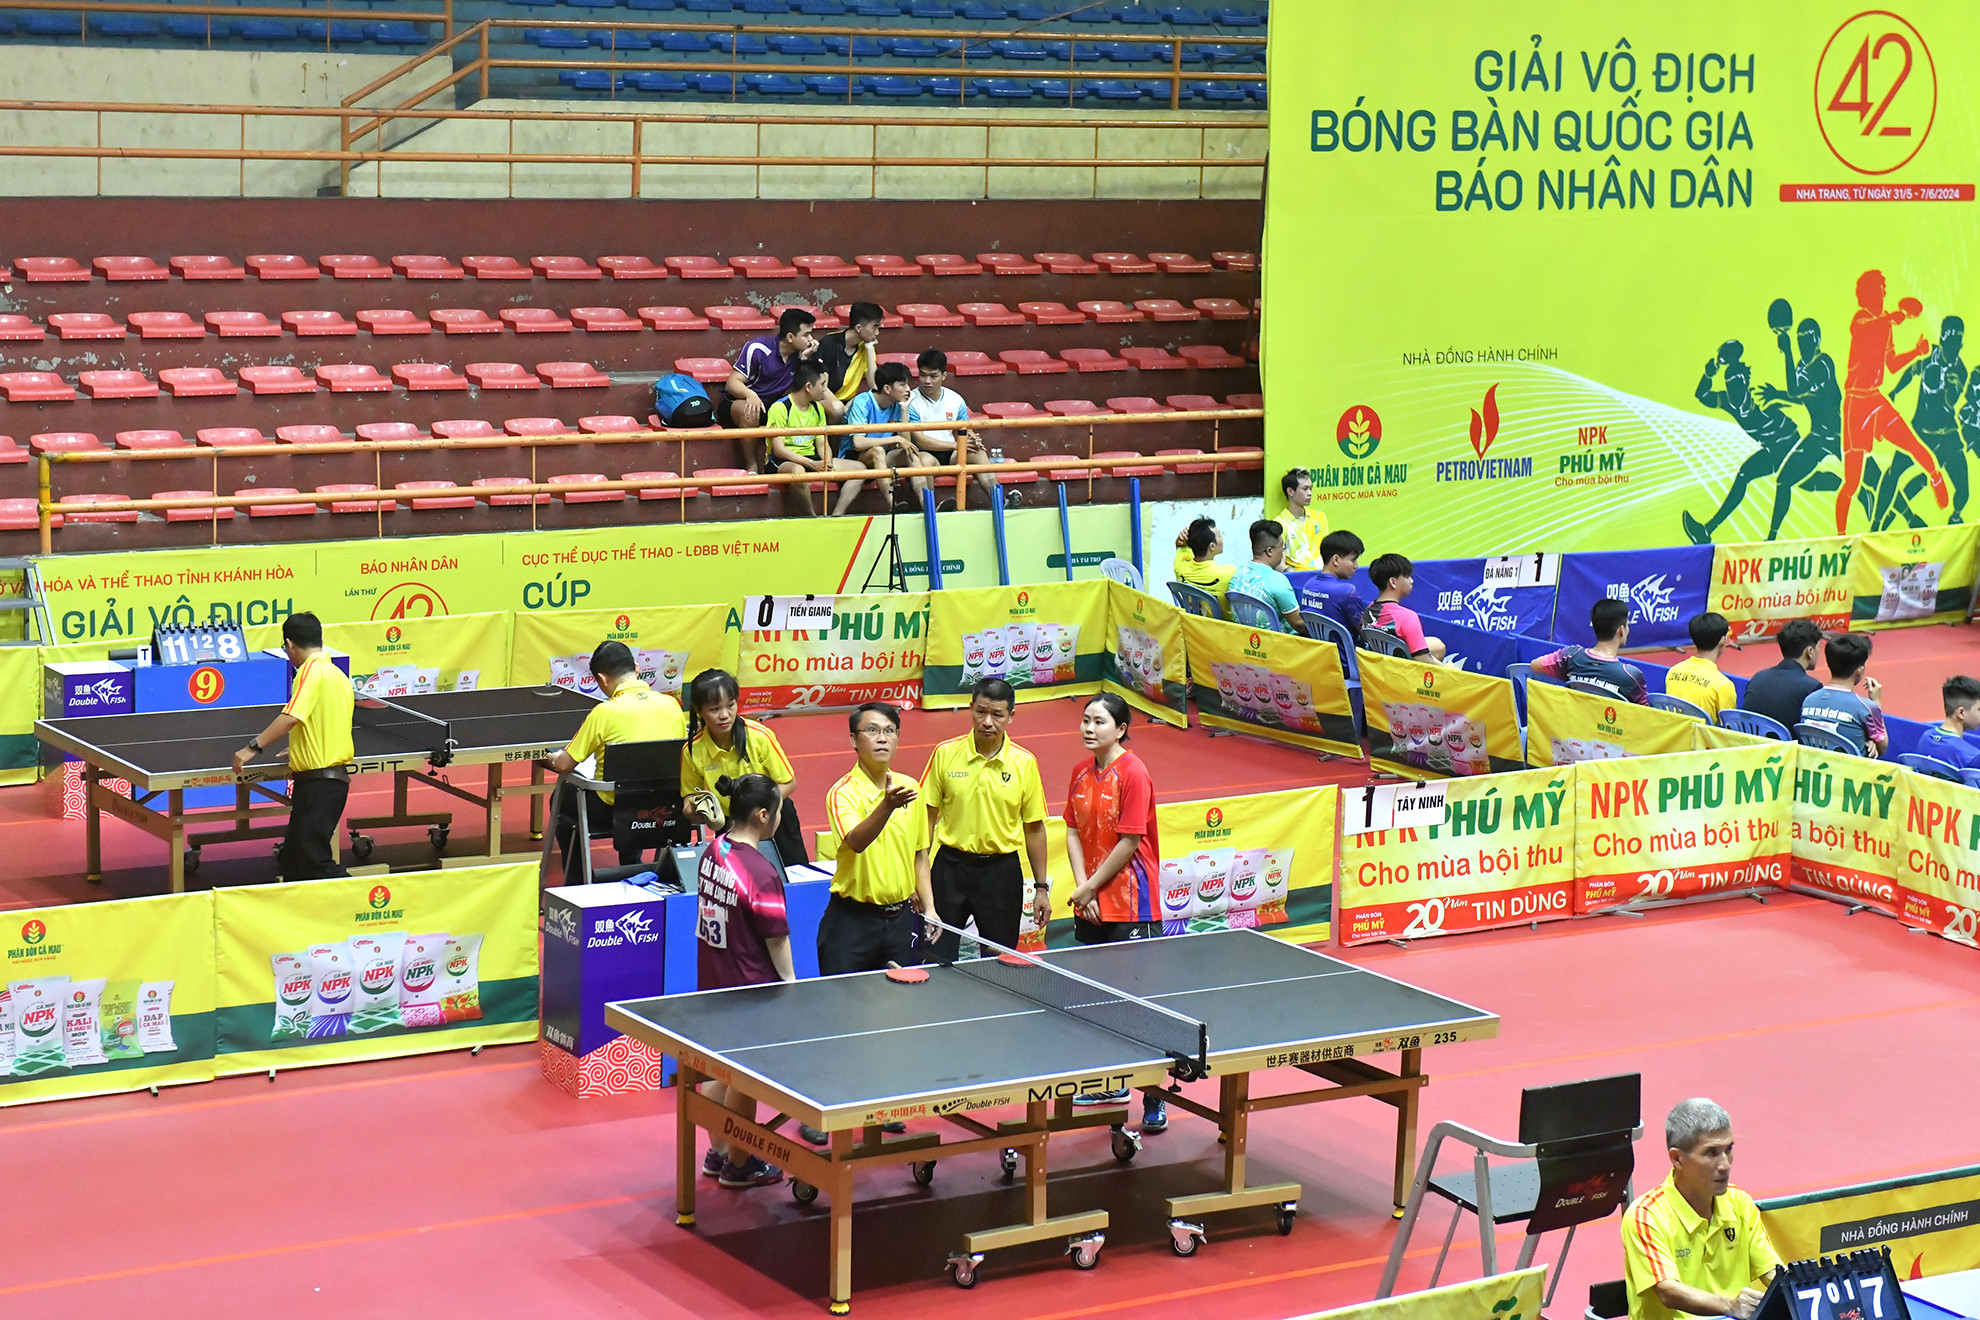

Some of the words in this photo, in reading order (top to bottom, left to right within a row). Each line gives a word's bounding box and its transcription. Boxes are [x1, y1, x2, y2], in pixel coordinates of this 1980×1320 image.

[1475, 34, 1562, 92] GIẢI
[1580, 37, 1636, 92] VÔ
[1652, 52, 1755, 103] ĐỊCH
[1827, 33, 1912, 136] 42
[1310, 96, 1436, 152] BÓNG
[1451, 97, 1539, 151] BÀN
[1554, 90, 1672, 152] QUỐC
[1686, 111, 1753, 151] GIA
[1436, 157, 1523, 211] BÁO
[1538, 154, 1655, 210] NHÂN
[1670, 154, 1752, 208] DÂN
[1796, 188, 1817, 199] NHA
[1818, 188, 1851, 201] TRANG,
[1853, 187, 1867, 199] TỪ
[1868, 186, 1892, 199] NGÀY
[1893, 188, 1912, 199] 31/5
[1920, 187, 1960, 200] 7/6/2024
[1403, 349, 1431, 365] NHÀ
[1436, 346, 1473, 364] ĐỒNG
[1478, 348, 1514, 362] HÀNH
[1518, 345, 1558, 361] CHÍNH
[1578, 426, 1608, 445] NPK
[1437, 457, 1532, 482] PETROVIETNAM
[1559, 449, 1593, 474] PHÚ
[1600, 447, 1625, 471] MỸ
[1310, 465, 1339, 488] PHÂN
[1343, 464, 1365, 485] BÓN
[1367, 461, 1381, 484] CÀ
[1385, 463, 1407, 483] MAU
[1555, 476, 1574, 487] Cho
[1576, 474, 1596, 485] mùa
[1598, 473, 1613, 486] bội
[1615, 474, 1629, 484] thu
[1317, 493, 1331, 502] HẠT
[1332, 491, 1356, 502] NGỌC
[1359, 488, 1374, 499] MÙA
[1376, 487, 1398, 498] VÀNG
[360, 558, 388, 575] BÁO
[391, 557, 428, 572] NHÂN
[432, 555, 459, 570] DÂN
[522, 554, 549, 567] CỤC
[553, 546, 578, 564] THỂ
[582, 550, 608, 563] DỤC
[611, 542, 636, 560] THỂ
[640, 547, 674, 559] THAO
[686, 545, 719, 557] LĐBB
[723, 540, 749, 554] VIỆT
[753, 541, 780, 553] NAM
[1534, 552, 1544, 582] 1
[1722, 558, 1763, 585] NPK
[1768, 547, 1813, 582] PHÚ
[1819, 545, 1852, 578] MỸ
[44, 576, 73, 592] HÓA
[78, 574, 97, 590] VÀ
[100, 570, 130, 588] THỂ
[136, 573, 172, 587] THAO
[178, 569, 210, 585] TỈNH
[214, 567, 262, 583] KHÁNH
[266, 565, 294, 580] HÒA
[523, 572, 591, 609] CÚP
[1721, 593, 1754, 611] Cho
[1758, 591, 1791, 609] mùa
[1796, 589, 1820, 608] bội
[1823, 587, 1847, 603] thu
[62, 598, 133, 639] GIẢI
[148, 595, 194, 627] VÔ
[757, 598, 774, 628] 0
[1489, 615, 1518, 632] FISH
[1654, 606, 1679, 622] FISH
[141, 648, 149, 661] T
[162, 636, 189, 662] 11
[190, 635, 198, 649] 1
[202, 634, 214, 648] 2
[217, 633, 241, 659] 8
[755, 653, 800, 674] Cho
[806, 652, 853, 671] mùa
[861, 651, 895, 675] bội
[901, 650, 925, 668] th
[196, 670, 217, 700] 9
[785, 685, 826, 708] 20
[849, 689, 877, 701] TIN
[881, 683, 924, 701] DÙN
[1591, 779, 1649, 819] NPK
[1658, 762, 1724, 813] PHÚ
[1735, 755, 1784, 804] MỸ
[1794, 762, 1832, 808] HÚ
[1842, 774, 1895, 820] MỸ
[1362, 786, 1375, 828] 1
[1397, 796, 1415, 812] TÂY
[1418, 795, 1444, 809] NINH
[1513, 779, 1567, 831] MỸ
[631, 821, 656, 829] DOUBLE
[663, 819, 676, 827] FISH
[1907, 795, 1962, 847] NPK
[1593, 833, 1642, 857] Cho
[1650, 828, 1696, 852] mùa
[1704, 822, 1740, 848] bội
[1749, 818, 1779, 841] thu
[1809, 820, 1844, 851] bội
[1853, 830, 1890, 859] thu
[1358, 862, 1410, 887] Cho
[1417, 854, 1471, 881] mùa
[1479, 846, 1519, 876] bội
[1527, 844, 1563, 868] thu
[1908, 849, 1949, 882] Cho
[1166, 886, 1192, 900] NPK
[1200, 877, 1226, 891] NPK
[1233, 876, 1256, 889] NPK
[1585, 888, 1602, 899] PHÚ
[1602, 887, 1616, 897] MỸ
[1629, 869, 1674, 902] 20
[1698, 872, 1728, 890] TIN
[1732, 862, 1782, 886] DÙNG
[1802, 867, 1832, 890] TIN
[1837, 874, 1893, 903] DÙNG
[1353, 919, 1370, 932] PHÚ
[1371, 917, 1386, 930] MỸ
[1403, 898, 1446, 937] 20
[1443, 896, 1469, 909] Năm
[1472, 901, 1505, 921] TIN
[1511, 890, 1567, 916] DÙNG
[1943, 905, 1977, 940] 20
[545, 922, 562, 938] Double
[587, 935, 623, 948] Double
[637, 932, 659, 943] FISH
[66, 1017, 92, 1028] KALI
[143, 1013, 163, 1022] DAP
[1434, 1031, 1457, 1045] 235
[1266, 1044, 1355, 1068] 世乒赛器材供应商
[1028, 1074, 1134, 1103] MOFIT
[965, 1100, 992, 1111] Double
[993, 1097, 1010, 1106] FISH
[724, 1116, 766, 1152] DOUBLE
[767, 1142, 791, 1163] FISH
[1841, 1227, 1865, 1243] NHÀ
[1868, 1219, 1899, 1238] ĐỒNG
[1901, 1216, 1932, 1232] HÀNH
[1934, 1210, 1969, 1226] CHÍNH
[1798, 1288, 1822, 1320] 7
[1826, 1282, 1840, 1304] 0
[1843, 1278, 1855, 1300] 1
[1859, 1276, 1884, 1319] 7
